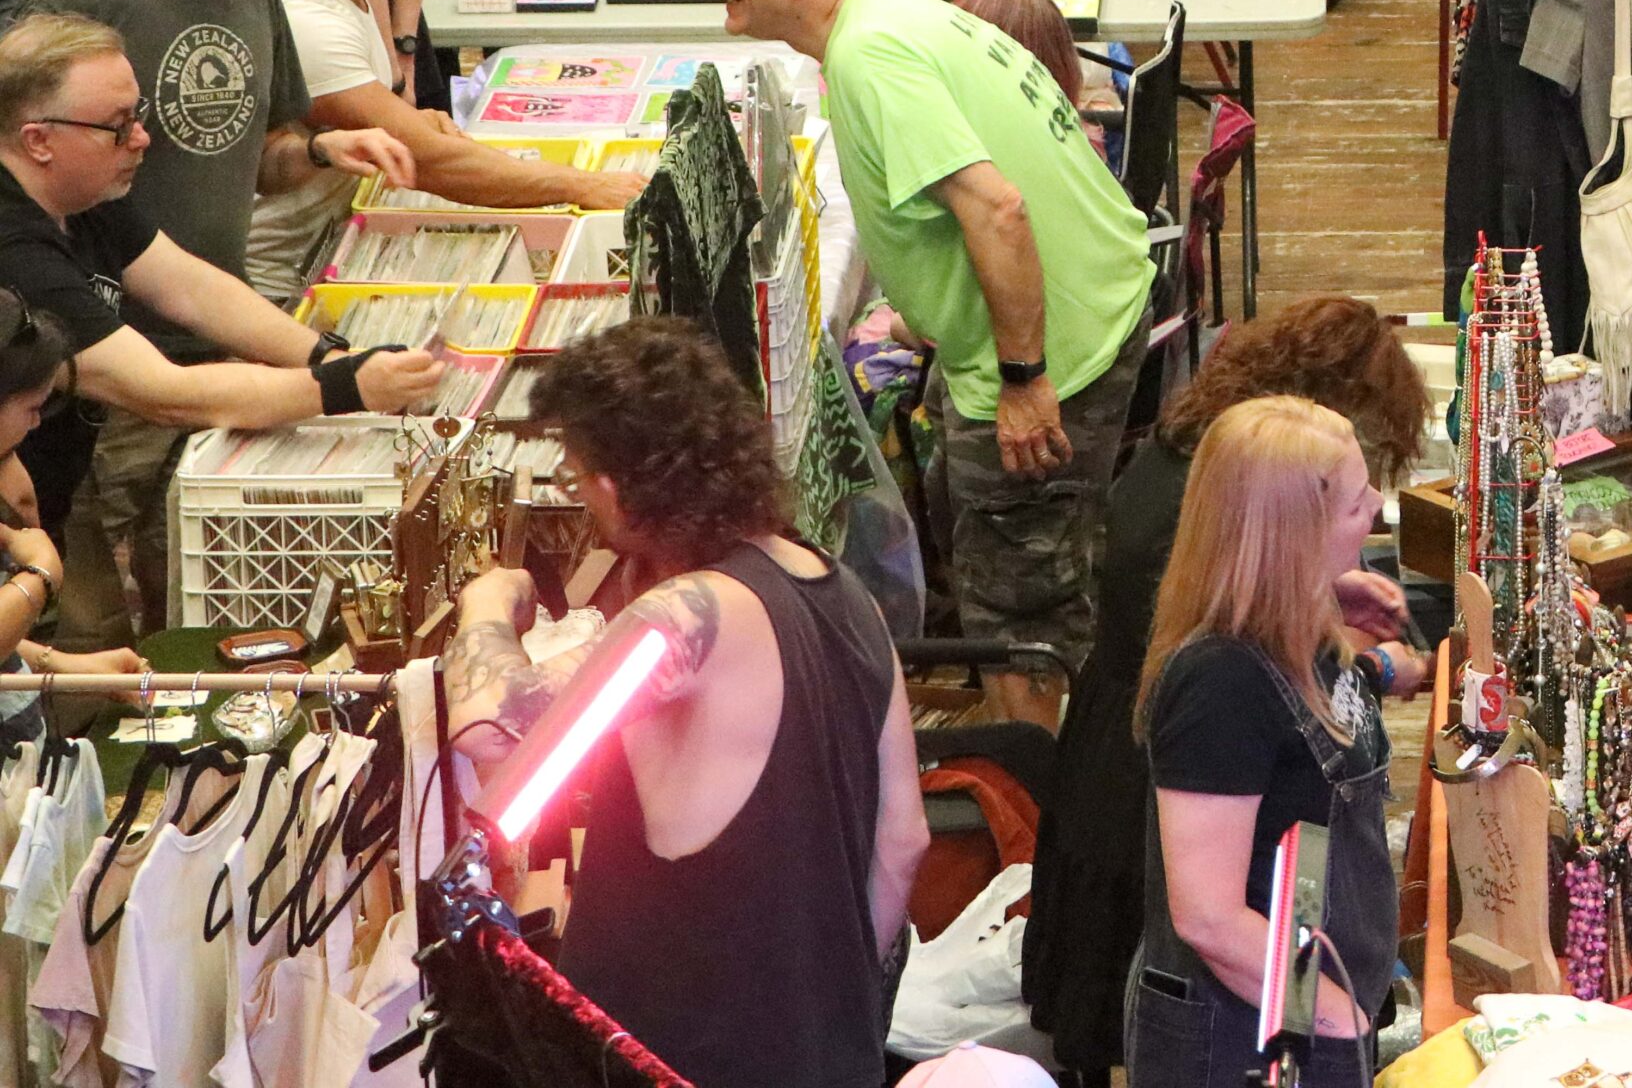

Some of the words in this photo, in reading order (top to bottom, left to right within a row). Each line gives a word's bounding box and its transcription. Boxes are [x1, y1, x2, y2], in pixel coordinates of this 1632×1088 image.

[164, 39, 191, 83] NEW
[192, 29, 253, 78] ZEALAND
[164, 101, 194, 140] NEW
[196, 95, 255, 148] ZEALAND
[191, 94, 214, 103] SINCE
